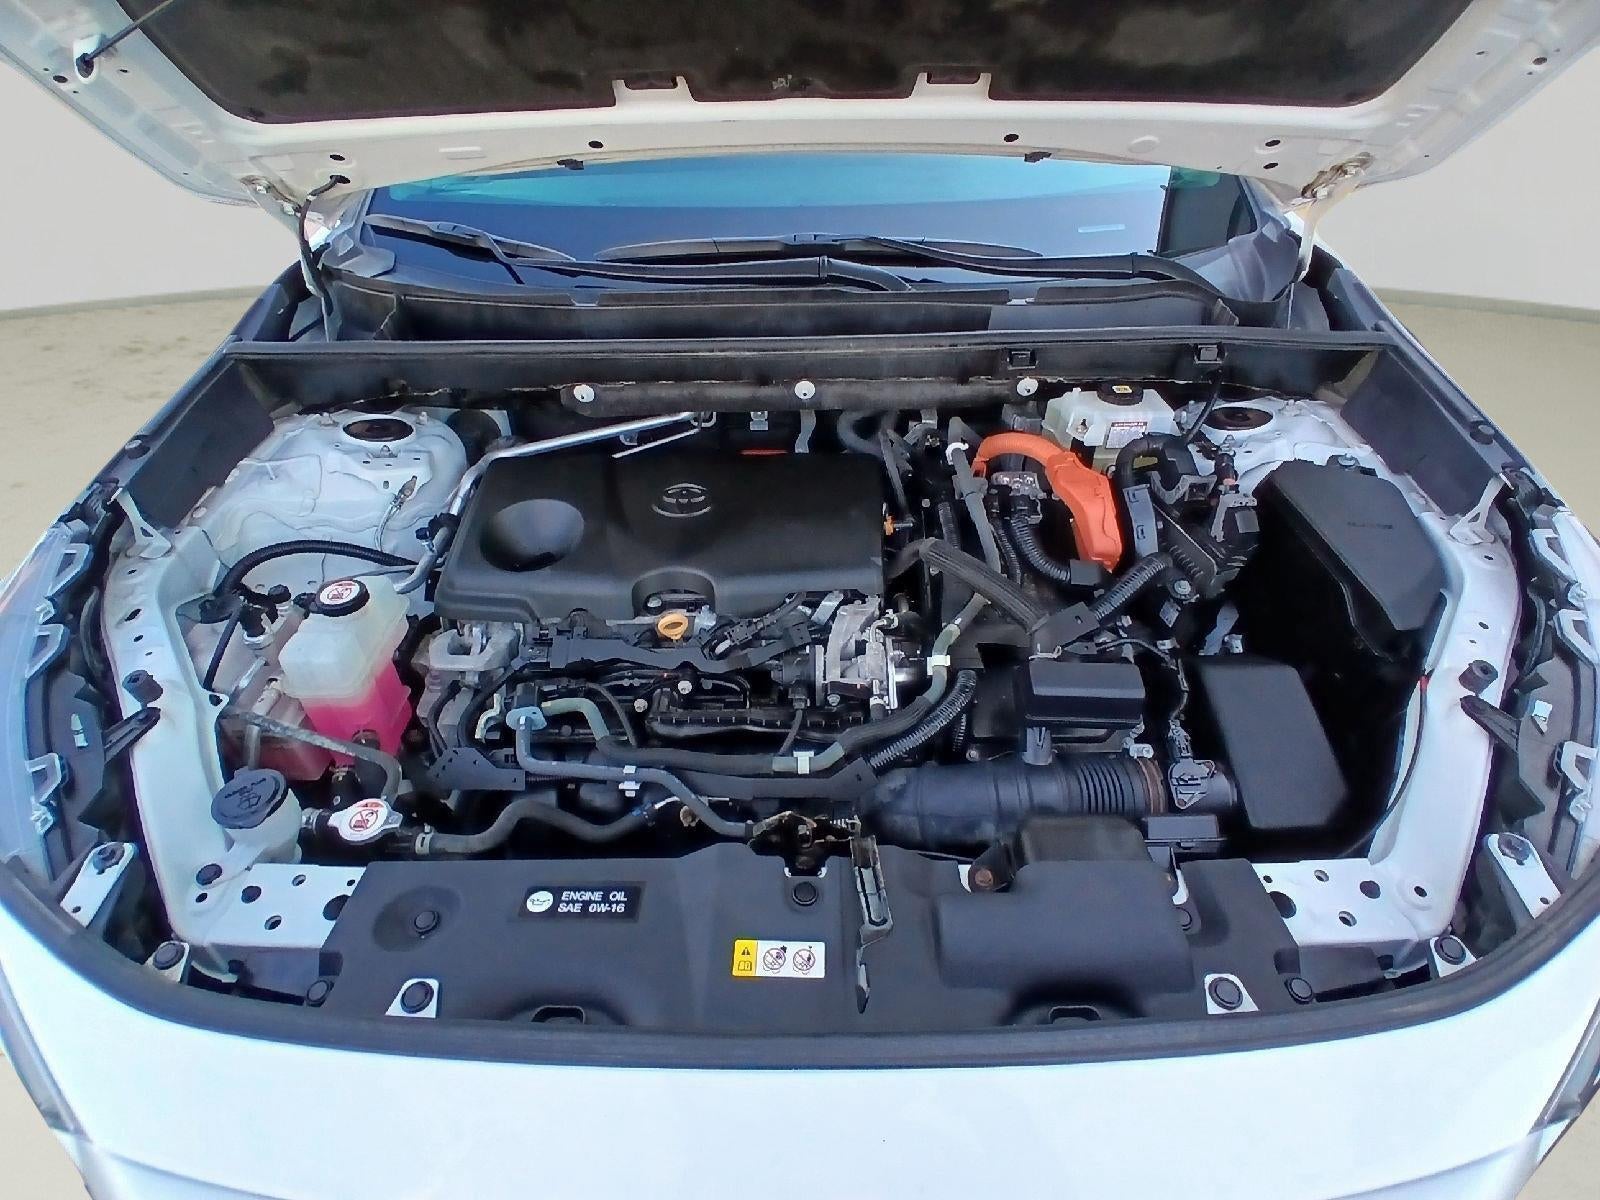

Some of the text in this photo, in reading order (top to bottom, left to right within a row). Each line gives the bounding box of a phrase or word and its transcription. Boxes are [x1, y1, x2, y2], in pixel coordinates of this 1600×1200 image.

[561, 891, 628, 901] ENGINE OIL
[557, 903, 626, 913] SAE 0W-16
